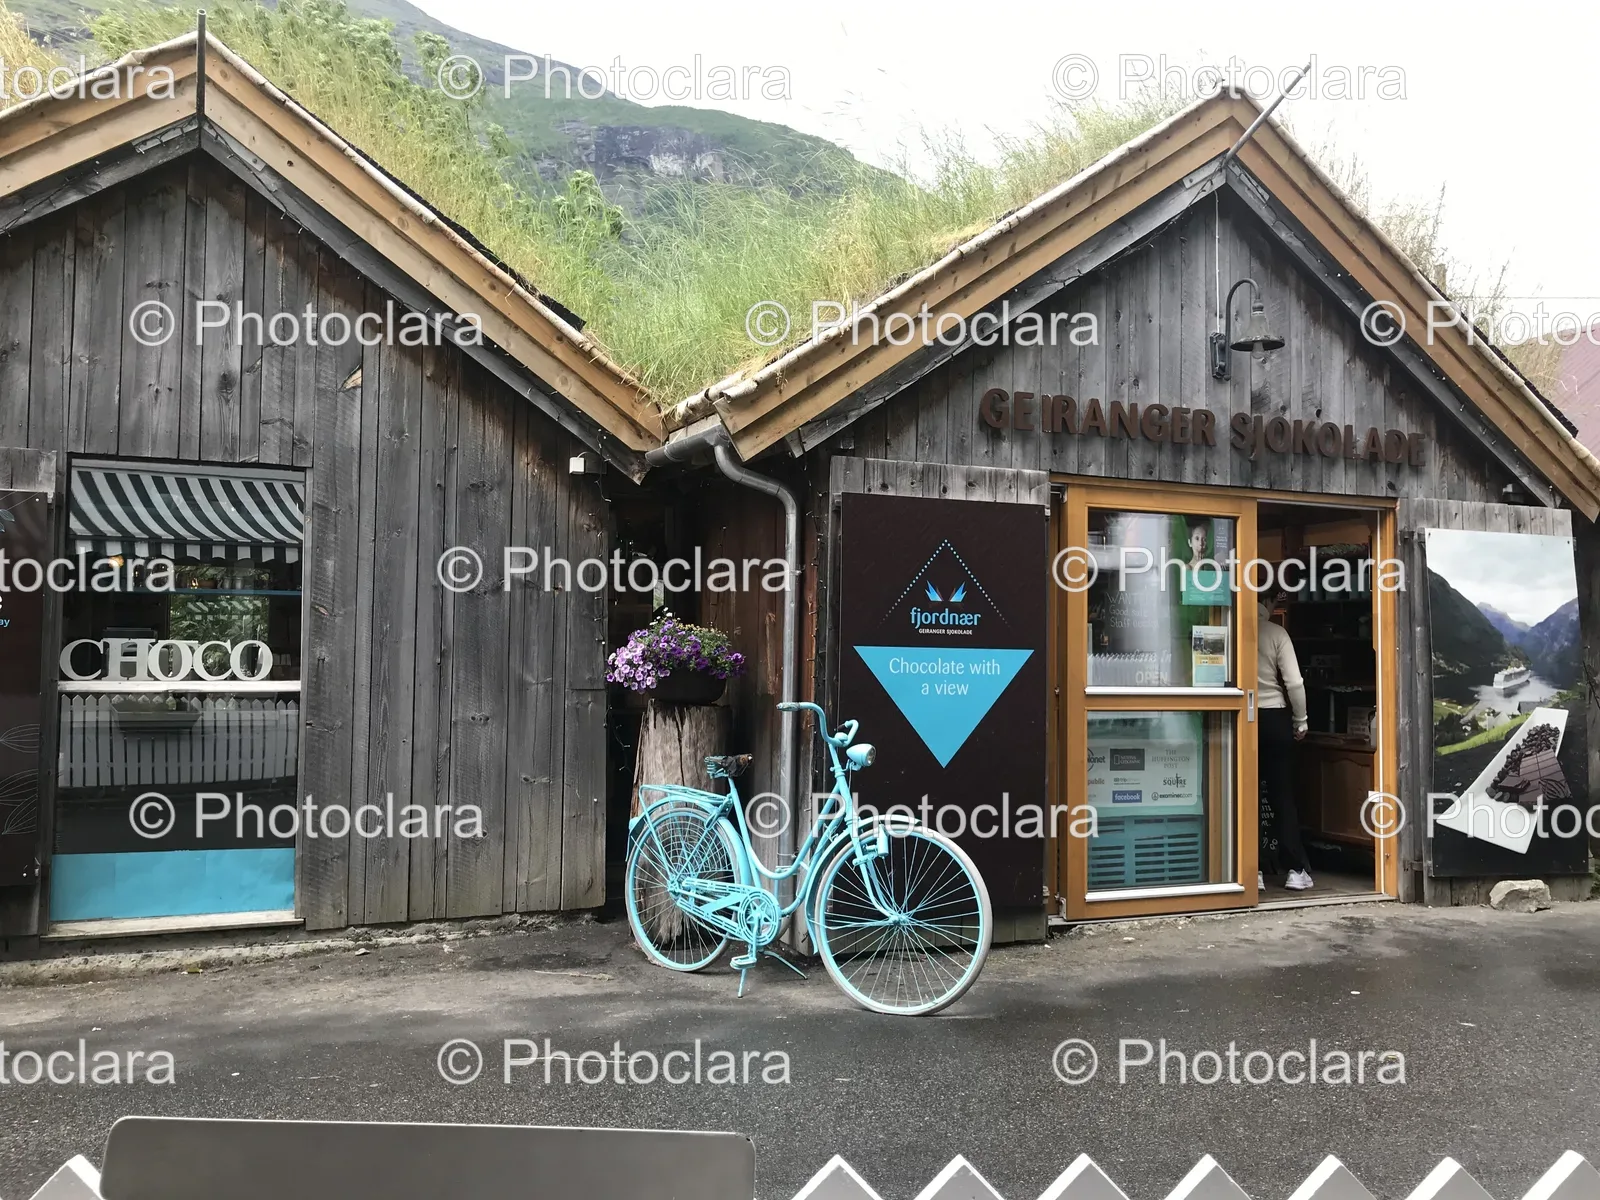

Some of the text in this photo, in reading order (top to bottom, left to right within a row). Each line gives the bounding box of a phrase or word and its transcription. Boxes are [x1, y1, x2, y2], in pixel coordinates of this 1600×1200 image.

[979, 387, 1426, 468] GEIRANGER SJOKOLADE
[910, 607, 981, 629] fjordnær
[59, 638, 274, 681] CHOCO
[889, 657, 1001, 675] Chocolate with
[1135, 670, 1169, 686] OPEN
[921, 680, 969, 695] a view
[1114, 793, 1141, 801] facebook
